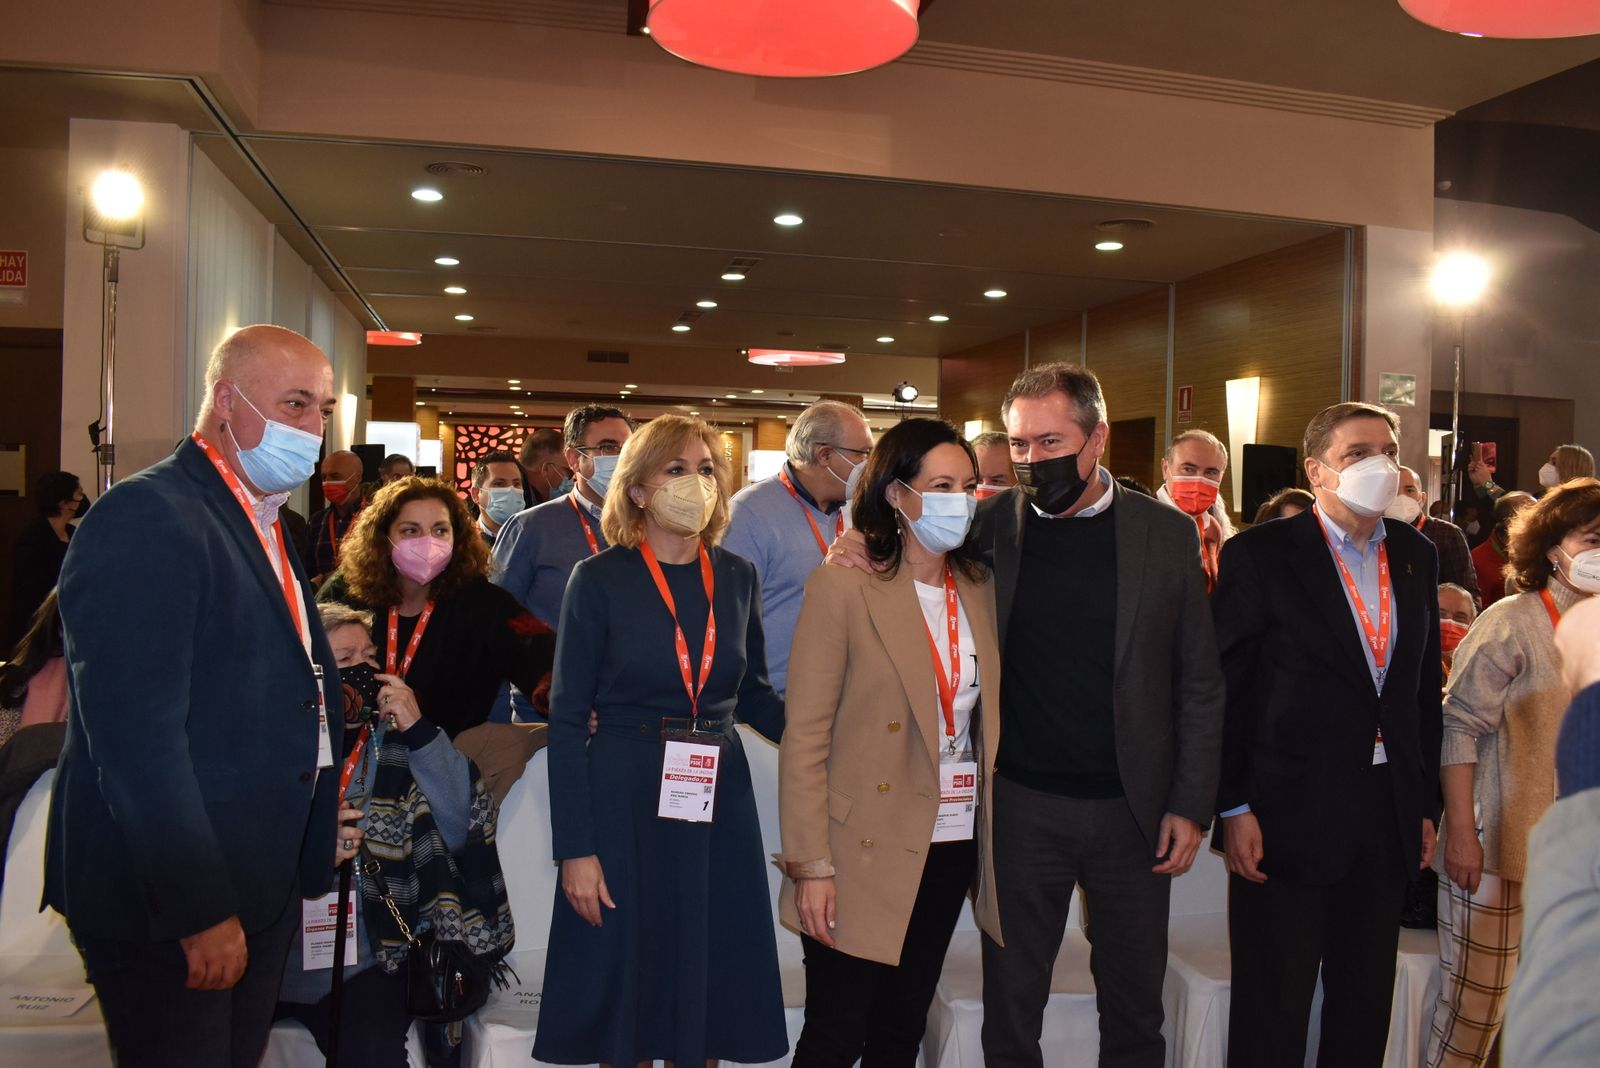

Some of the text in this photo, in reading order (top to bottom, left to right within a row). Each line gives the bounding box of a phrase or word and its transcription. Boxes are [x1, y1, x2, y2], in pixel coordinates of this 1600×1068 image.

[0, 270, 23, 282] IDA
[670, 774, 708, 783] Delegado/a
[702, 801, 710, 811] 1
[10, 995, 75, 1003] ANTONIO
